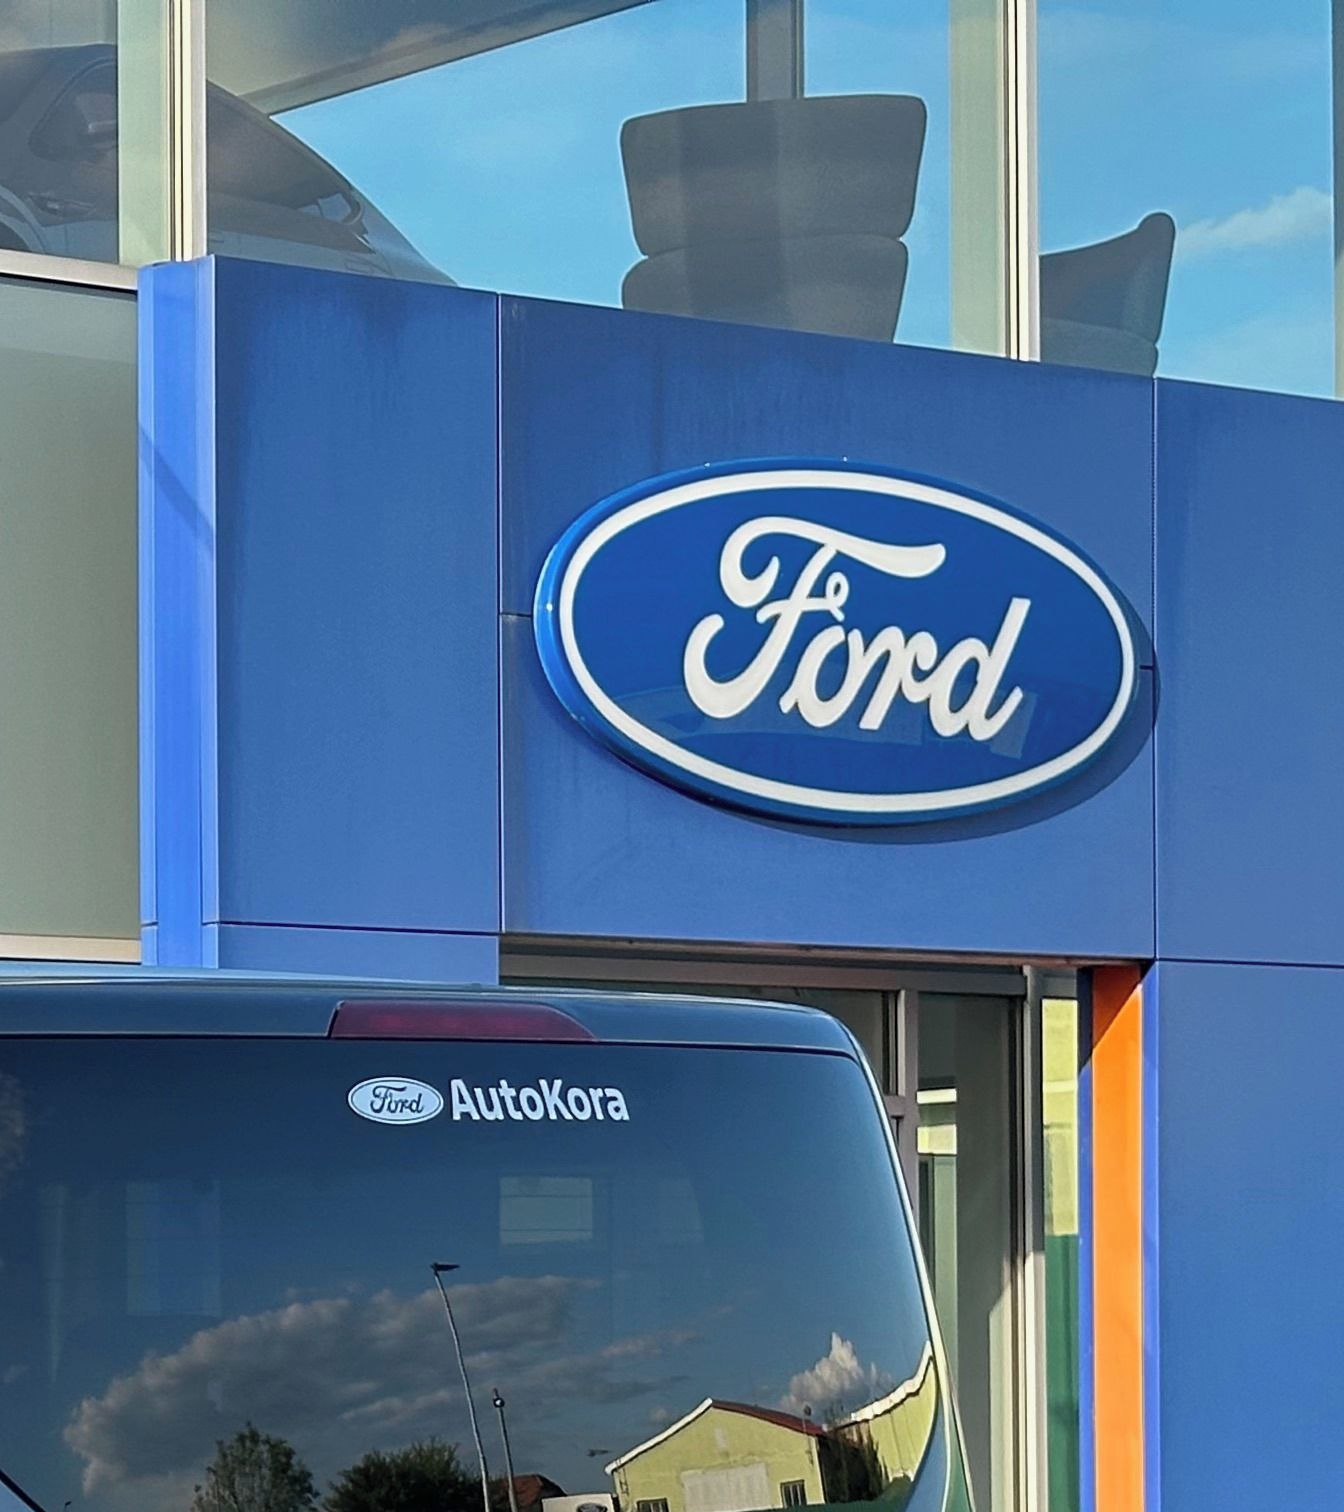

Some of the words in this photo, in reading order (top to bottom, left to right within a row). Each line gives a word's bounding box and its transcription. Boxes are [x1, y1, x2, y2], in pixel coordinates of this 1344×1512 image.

[684, 516, 1031, 741] Ford
[369, 1085, 425, 1115] Ford
[451, 1079, 630, 1121] AutoKora
